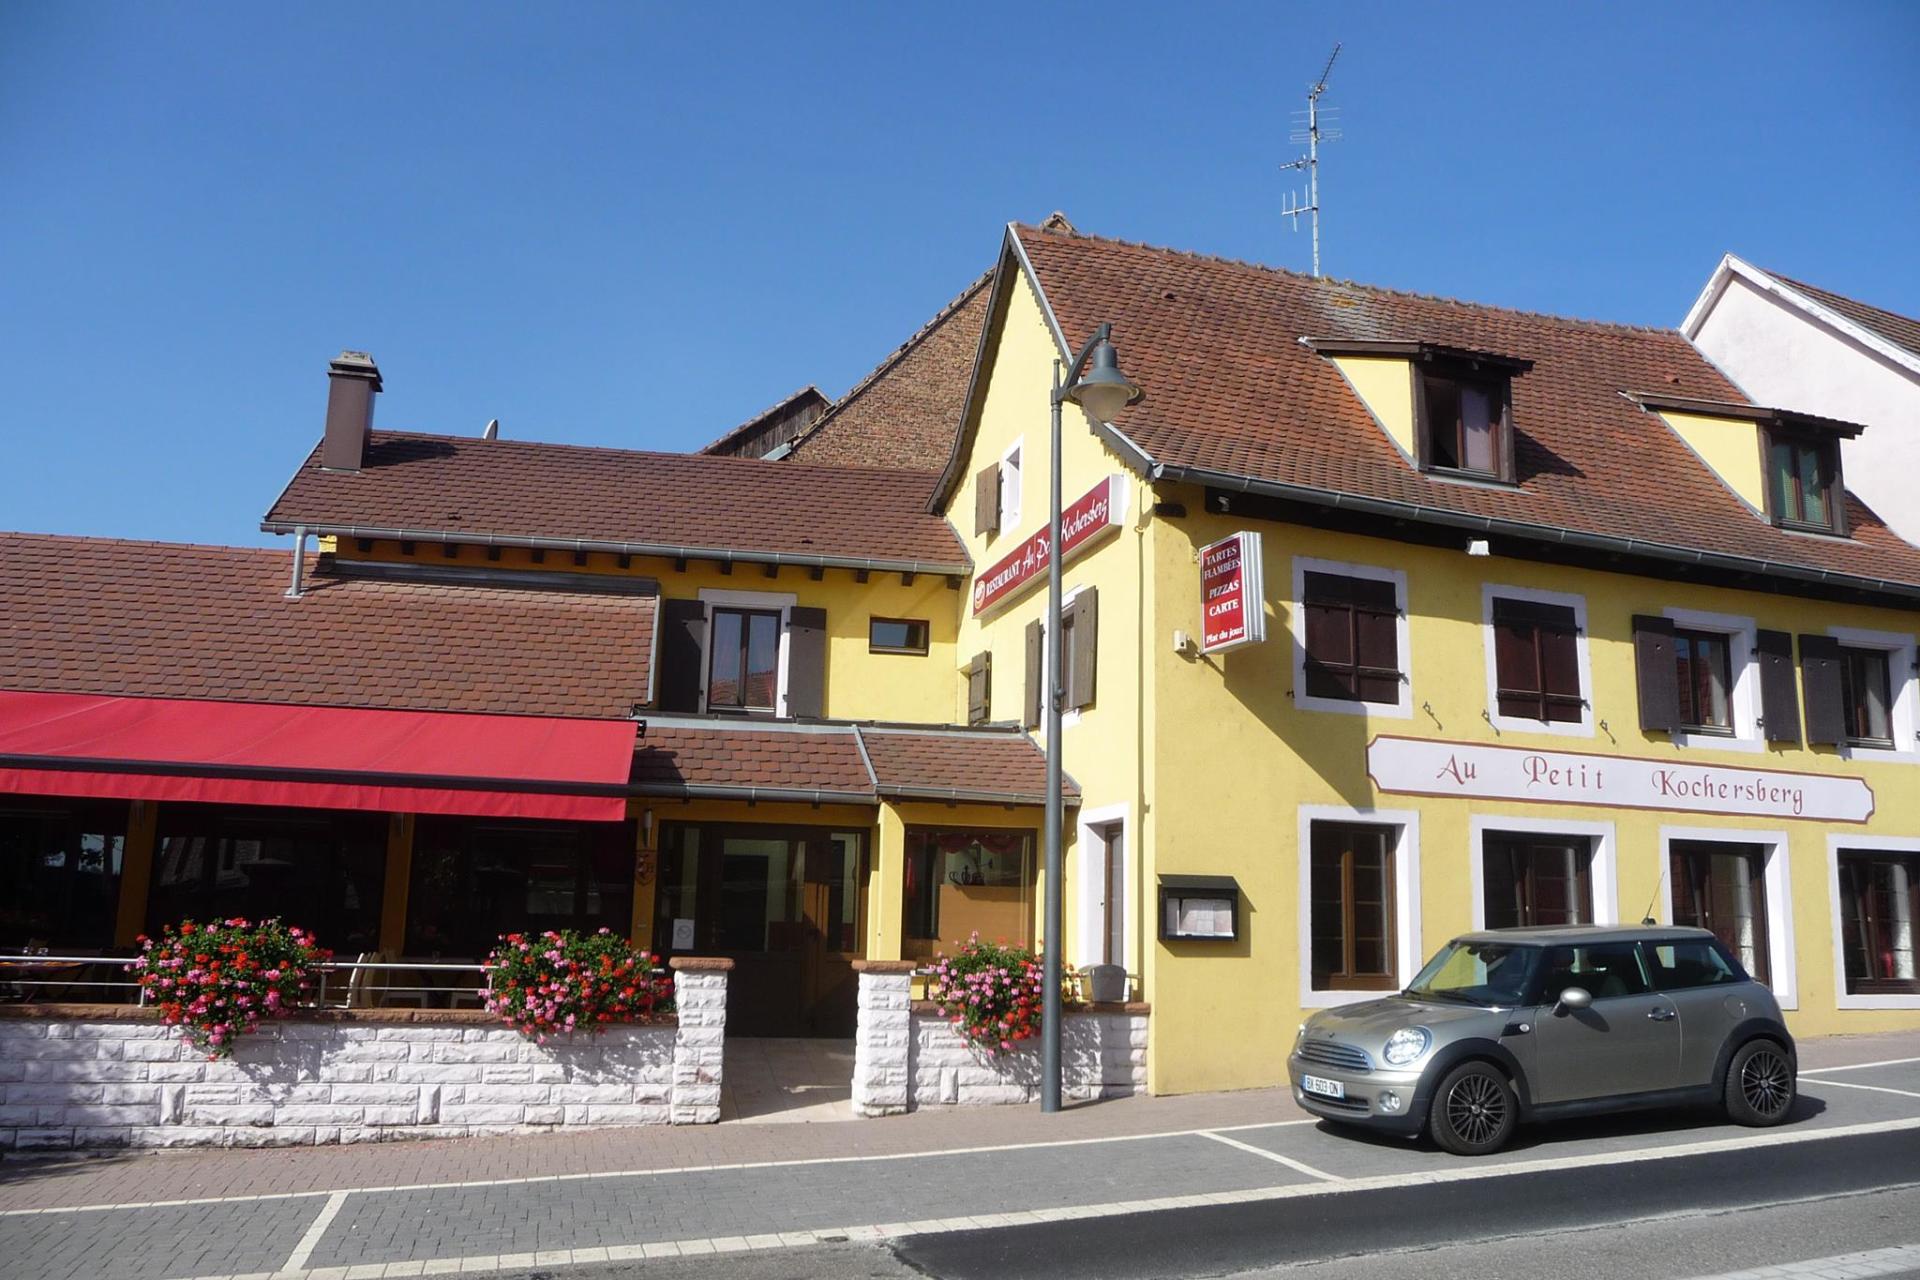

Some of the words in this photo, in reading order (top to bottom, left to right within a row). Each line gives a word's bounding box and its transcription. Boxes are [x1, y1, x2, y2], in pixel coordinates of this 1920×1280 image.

[986, 560, 1020, 597] RESTAURANT
[1022, 545, 1034, 577] Au
[1061, 498, 1107, 542] Kochersberg
[1207, 546, 1237, 566] TARTES
[1204, 558, 1241, 580] FLAMBÉES
[1209, 580, 1239, 599] PIZZAS
[1209, 599, 1239, 617] CARTE
[1206, 634, 1219, 644] Plat
[1220, 630, 1228, 640] du
[1229, 627, 1243, 639] jour
[1436, 754, 1476, 785] Au
[1523, 755, 1603, 789] Petit
[1652, 770, 1803, 815] Kochersberg
